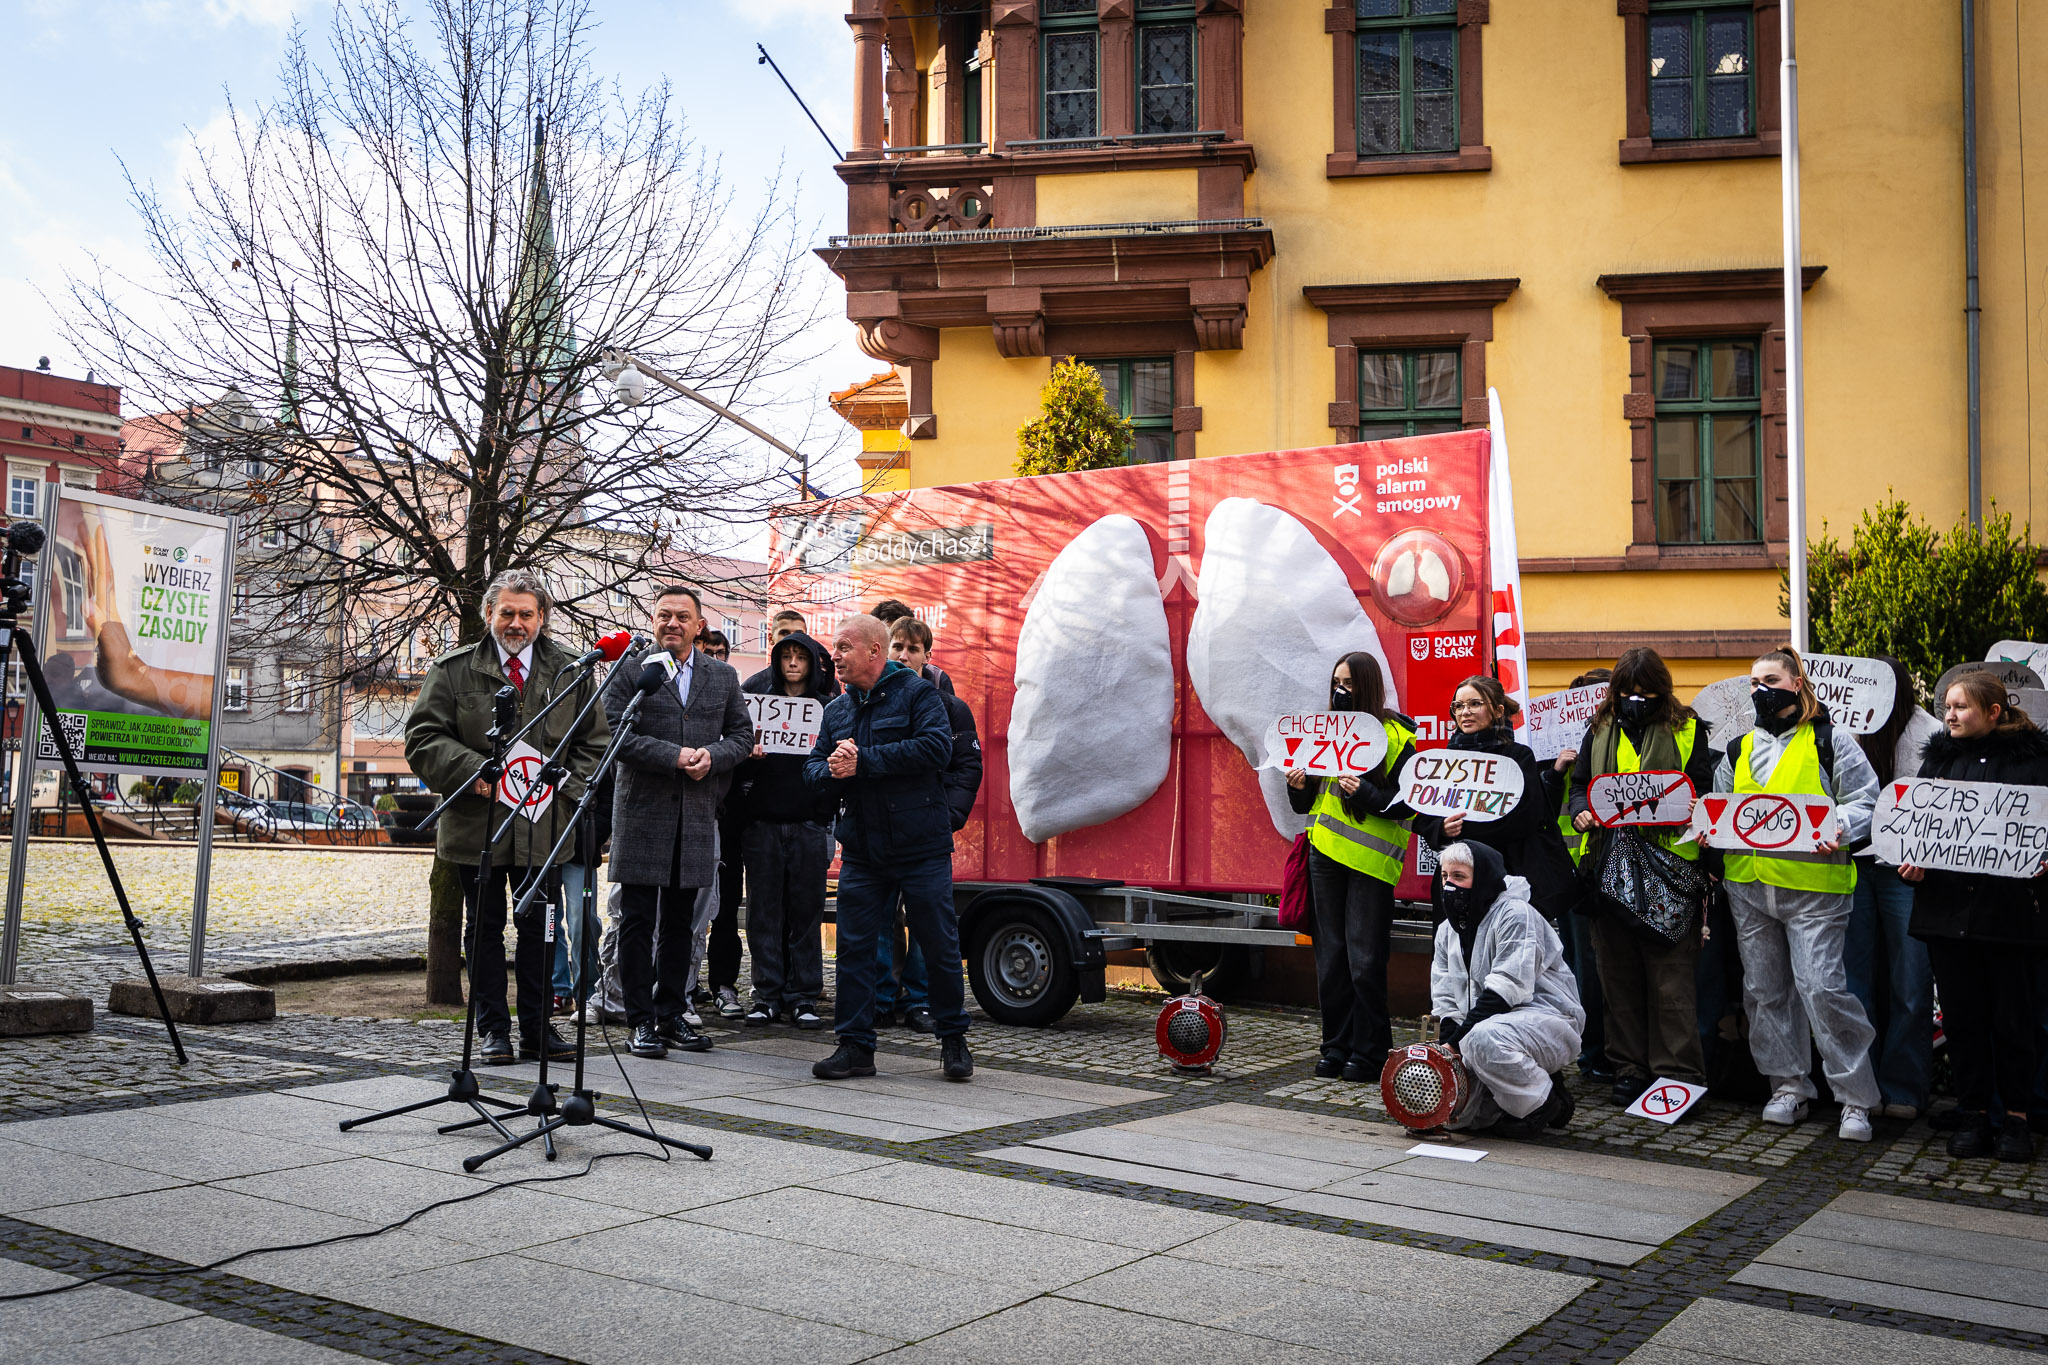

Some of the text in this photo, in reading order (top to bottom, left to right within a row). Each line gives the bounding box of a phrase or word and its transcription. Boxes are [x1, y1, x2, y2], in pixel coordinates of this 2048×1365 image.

[1377, 457, 1428, 479] polski
[1376, 479, 1425, 494] alarm
[1377, 495, 1461, 513] smogowy
[866, 529, 987, 564] oddychasz!
[144, 562, 211, 592] WYBIERZ
[141, 586, 209, 618] CZYSTE
[138, 614, 208, 644] ZASADY
[1434, 635, 1477, 647] DOLNY
[1434, 646, 1474, 659] ŚLĄSK
[1565, 690, 1593, 706] LECI,
[128, 721, 141, 732] JAK
[143, 723, 170, 734] ZADBAĆ
[171, 725, 176, 734] O
[176, 725, 202, 737] JAKOŚĆ
[1278, 714, 1356, 737] CHCEMY
[1530, 717, 1542, 731] SZ
[90, 732, 194, 747] POWIETRZA W TWOJEJ OKOLICY
[119, 753, 204, 768] WWW.CZYSTEZASADY.PL
[1414, 757, 1498, 784] CZYSTE
[1605, 783, 1664, 802] SMOGOWI
[1912, 782, 1979, 812] CZAS
[1984, 787, 2030, 817] NA
[1738, 807, 1794, 831] SMOG
[1650, 1094, 1680, 1106] SMOG
